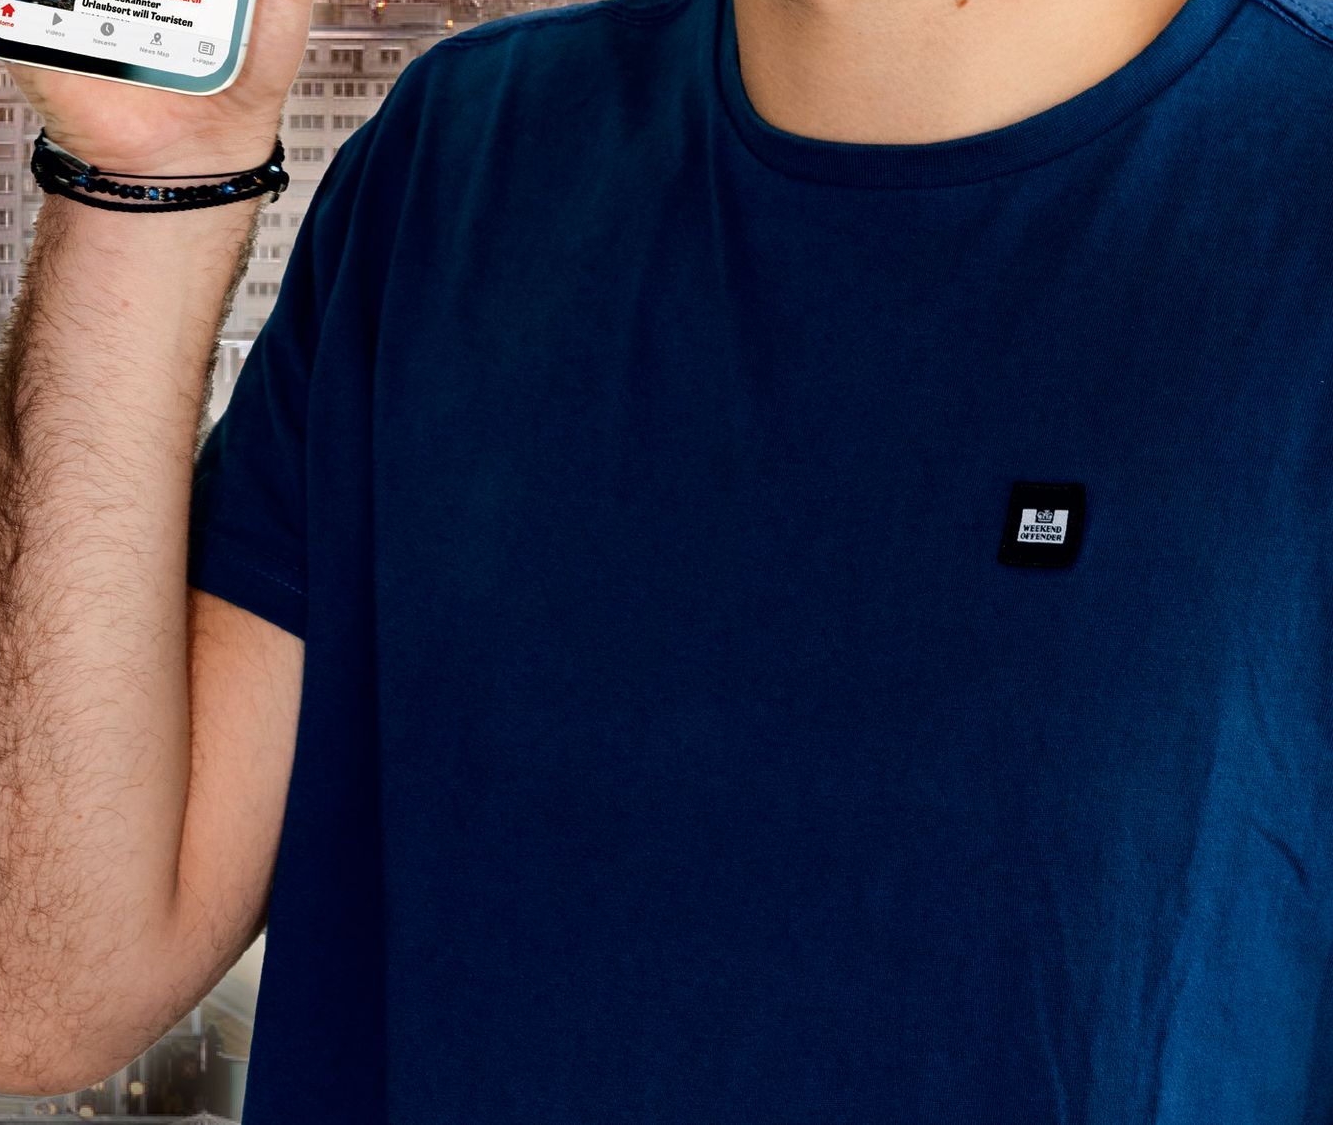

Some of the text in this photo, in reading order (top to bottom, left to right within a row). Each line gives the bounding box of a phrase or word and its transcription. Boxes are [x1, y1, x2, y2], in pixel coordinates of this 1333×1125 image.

[132, 9, 150, 19] will
[150, 11, 194, 28] Touristen
[1023, 524, 1063, 533] WEEKEND
[1020, 532, 1062, 541] OFFENDER
